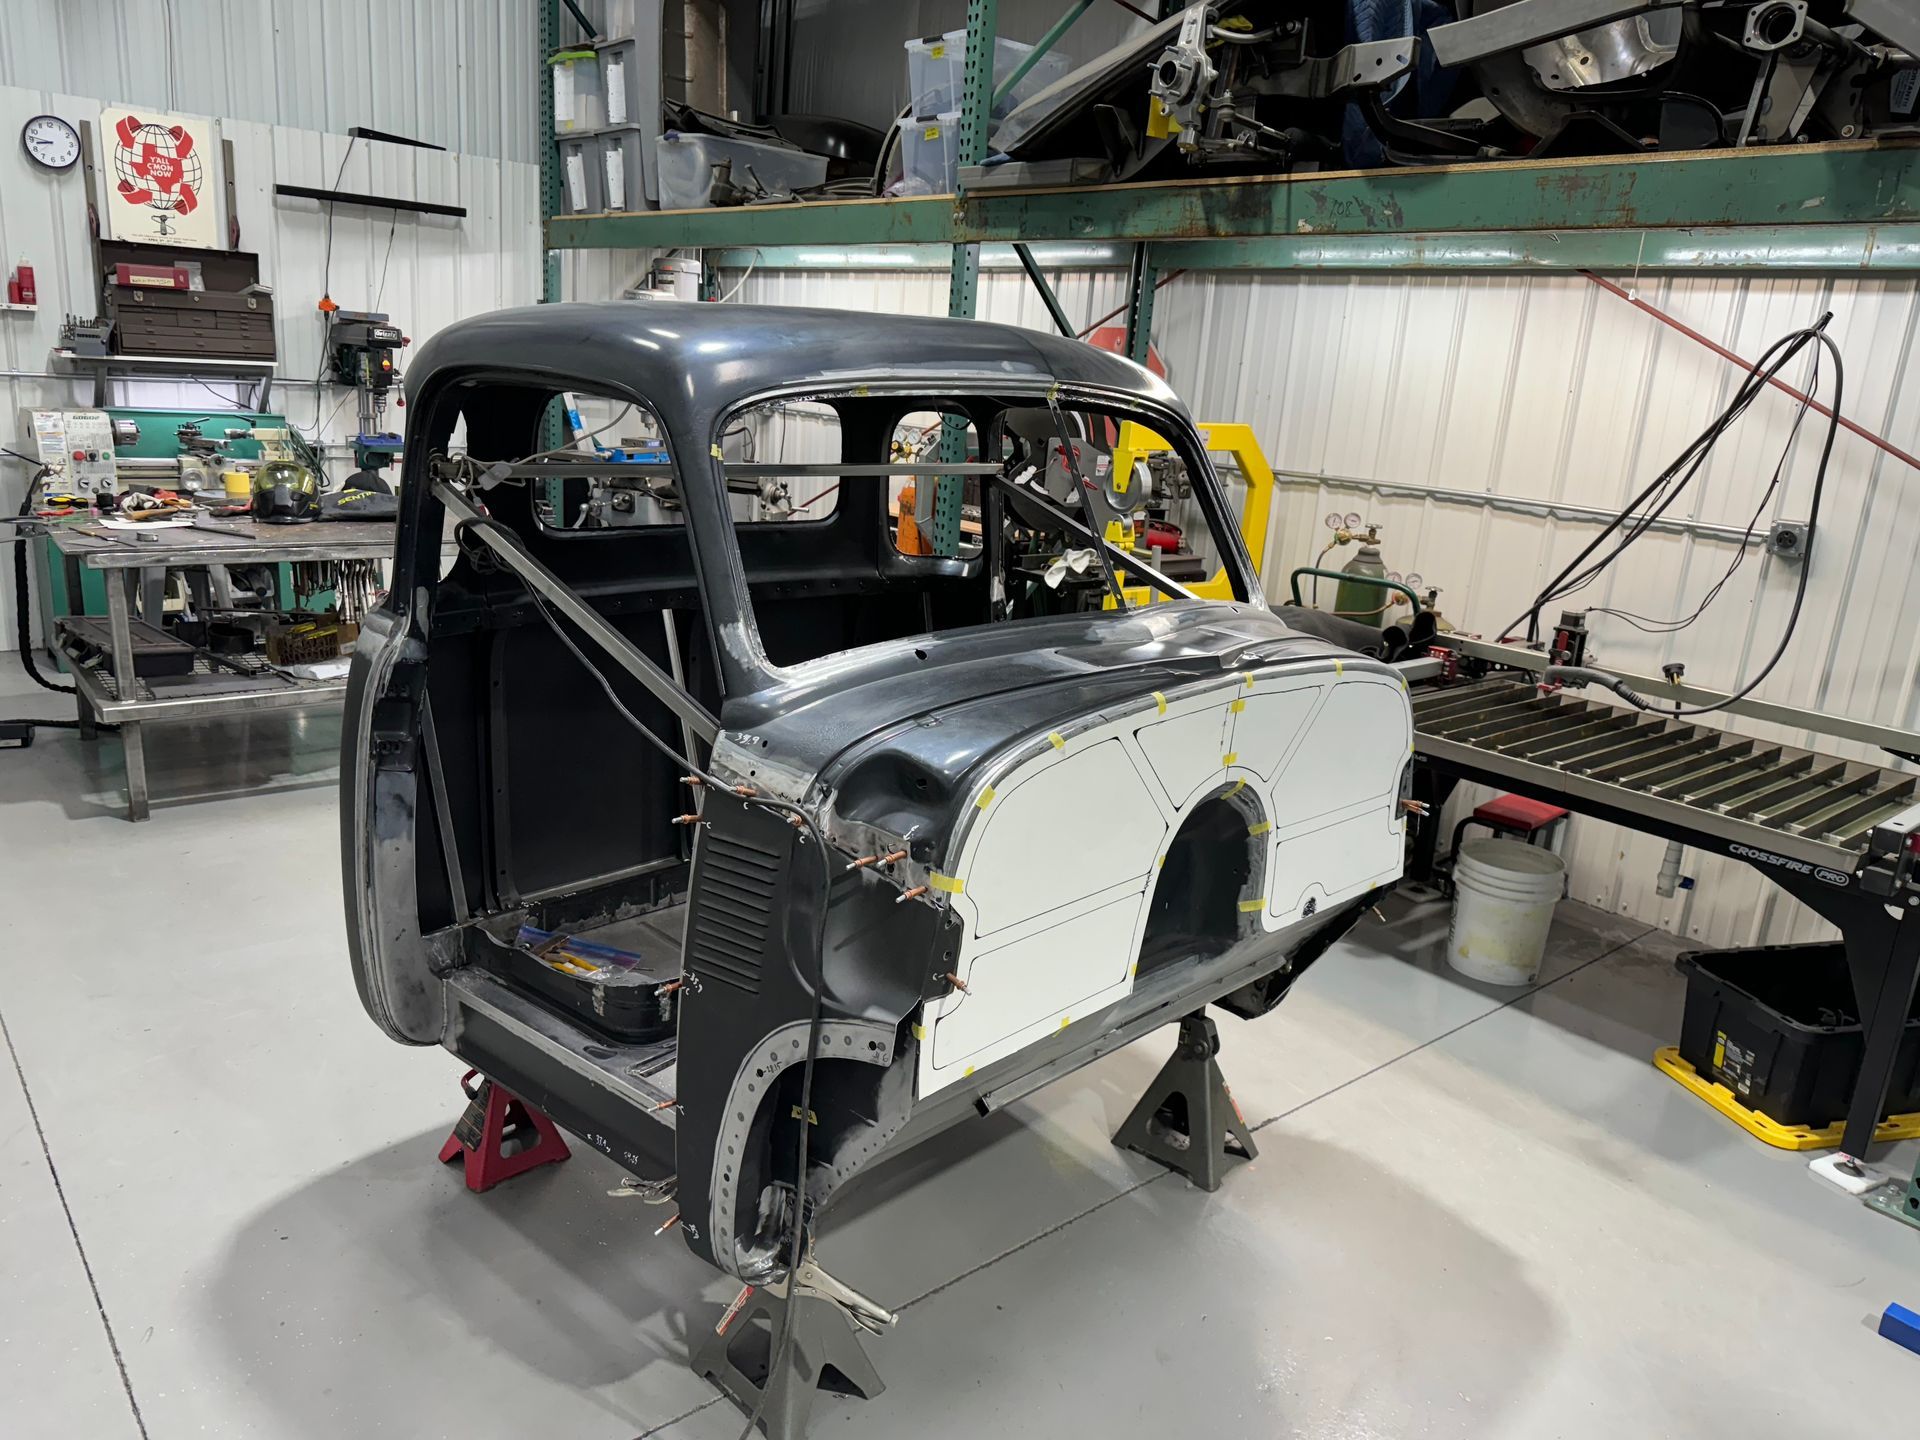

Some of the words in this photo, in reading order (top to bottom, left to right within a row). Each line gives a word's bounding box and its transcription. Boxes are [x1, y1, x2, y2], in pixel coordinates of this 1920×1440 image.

[28, 135, 34, 143] 9
[149, 156, 169, 165] Y'ALL
[147, 162, 173, 172] C'MON
[150, 169, 171, 178] NOW
[1729, 843, 1814, 875] CROSSFIRE
[1819, 870, 1846, 884] PRO
